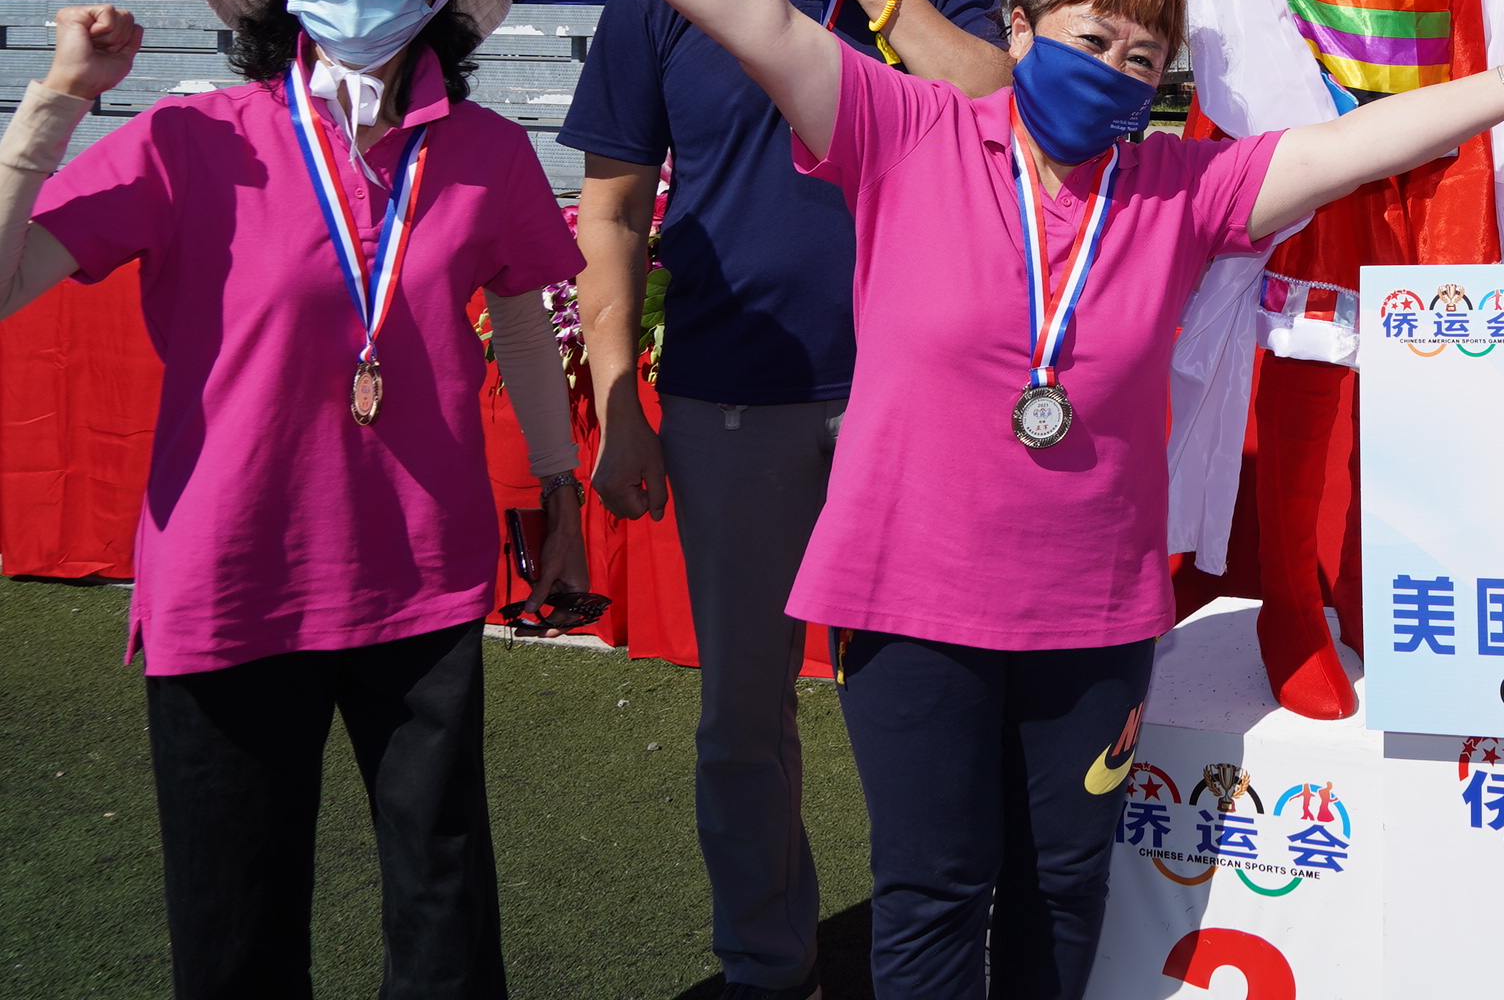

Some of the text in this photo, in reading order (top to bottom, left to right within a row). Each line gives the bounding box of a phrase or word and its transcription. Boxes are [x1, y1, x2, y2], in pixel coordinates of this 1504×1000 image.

[1114, 800, 1351, 873] 侨运会
[1138, 847, 1321, 880] CHINESE AMERICAN SPORTS GAME
